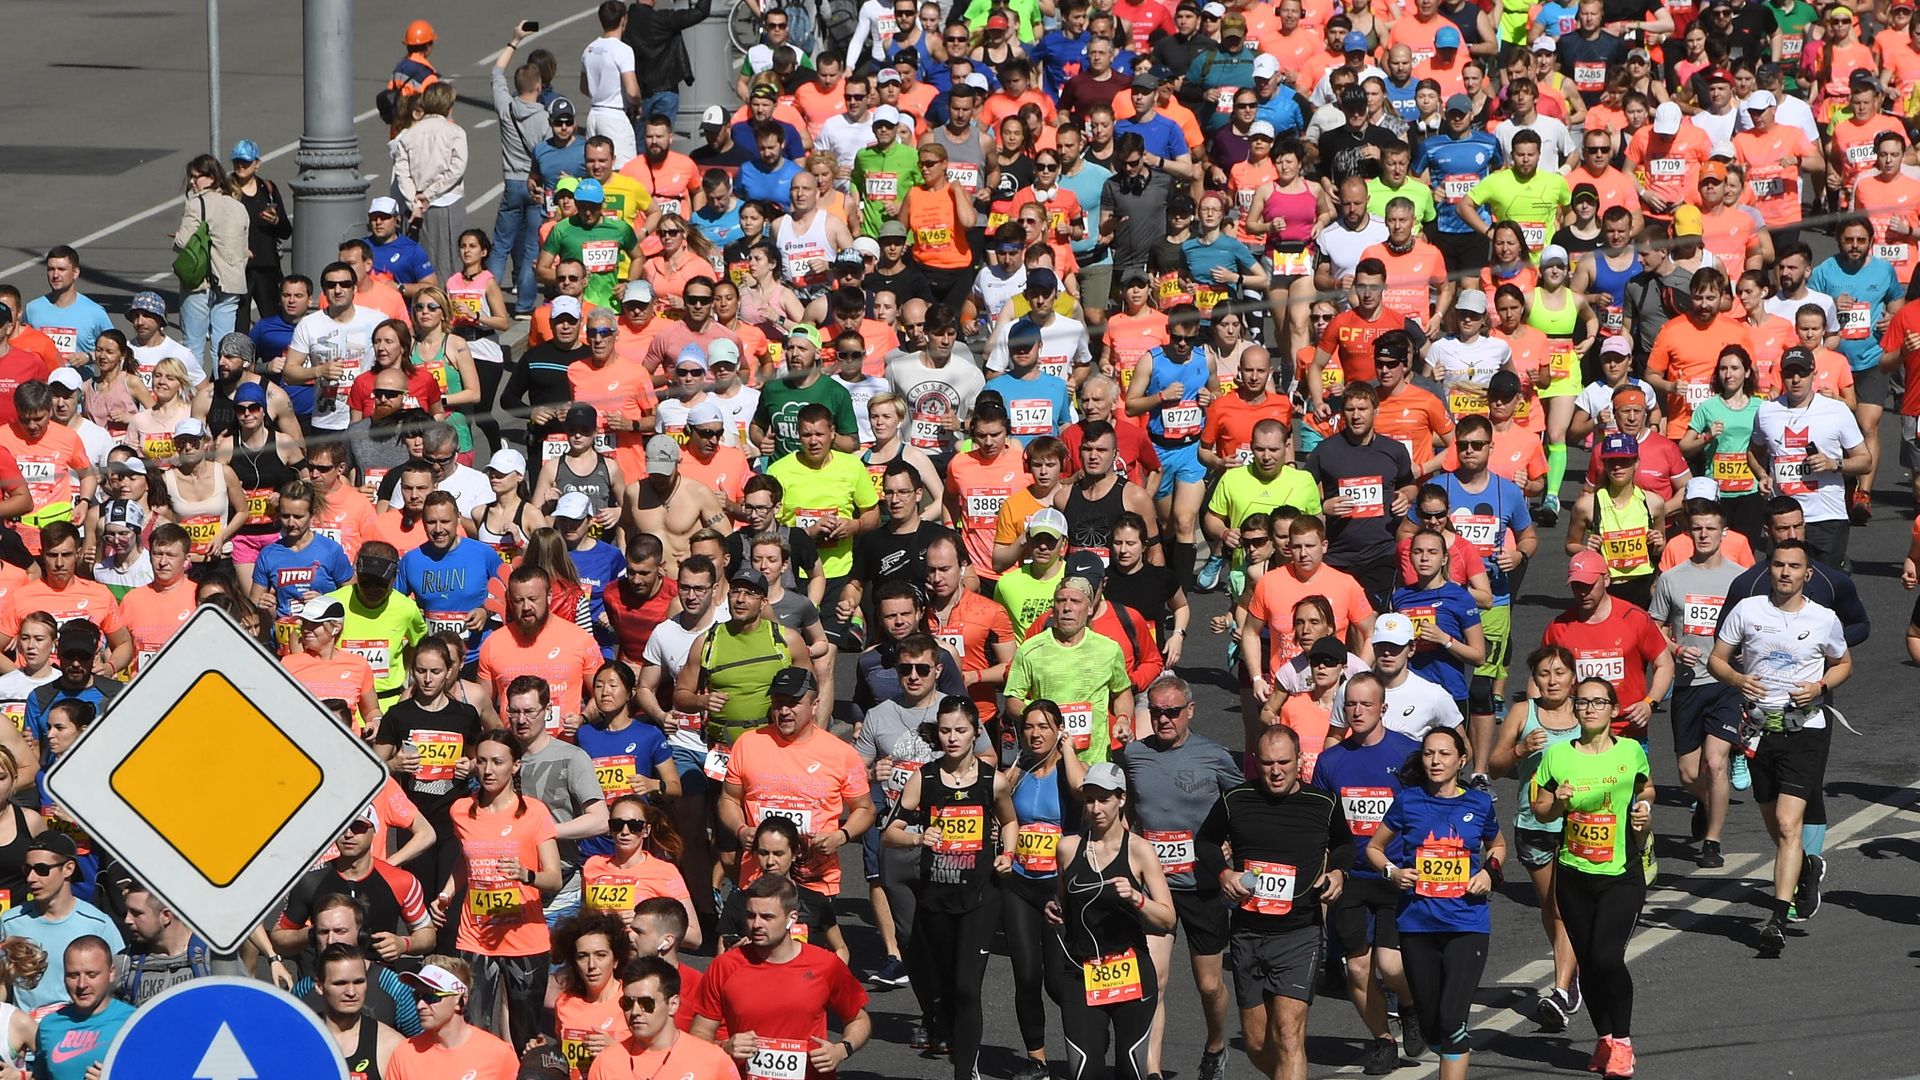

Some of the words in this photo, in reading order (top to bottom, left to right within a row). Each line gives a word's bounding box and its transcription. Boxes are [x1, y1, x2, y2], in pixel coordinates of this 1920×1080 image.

[1578, 69, 1601, 80] 2485
[1656, 160, 1681, 171] 1709
[947, 171, 971, 181] 9449
[869, 180, 892, 190] 7722
[587, 249, 614, 262] 5597
[1879, 247, 1898, 257] 869
[1476, 368, 1494, 376] RUN
[909, 382, 957, 402] CROSSFIT
[1016, 408, 1047, 422] 5147
[1166, 409, 1196, 423] 8727
[778, 421, 801, 439] RU
[1718, 462, 1749, 474] 8572
[1610, 538, 1642, 554] 5756
[421, 568, 464, 594] RUN
[1691, 606, 1718, 621] 852
[1577, 661, 1622, 678] 10215
[418, 744, 456, 760] 2547
[1348, 799, 1386, 815] 4820
[937, 818, 977, 835] 9582
[1571, 823, 1608, 841] 9453
[1152, 843, 1186, 859] 225
[1422, 859, 1461, 876] 8296
[474, 891, 512, 909] 4152
[590, 887, 627, 903] 7432
[1092, 962, 1131, 982] 3869
[1092, 990, 1099, 1000] F
[62, 1030, 99, 1048] RUN
[751, 1050, 798, 1072] 4368
